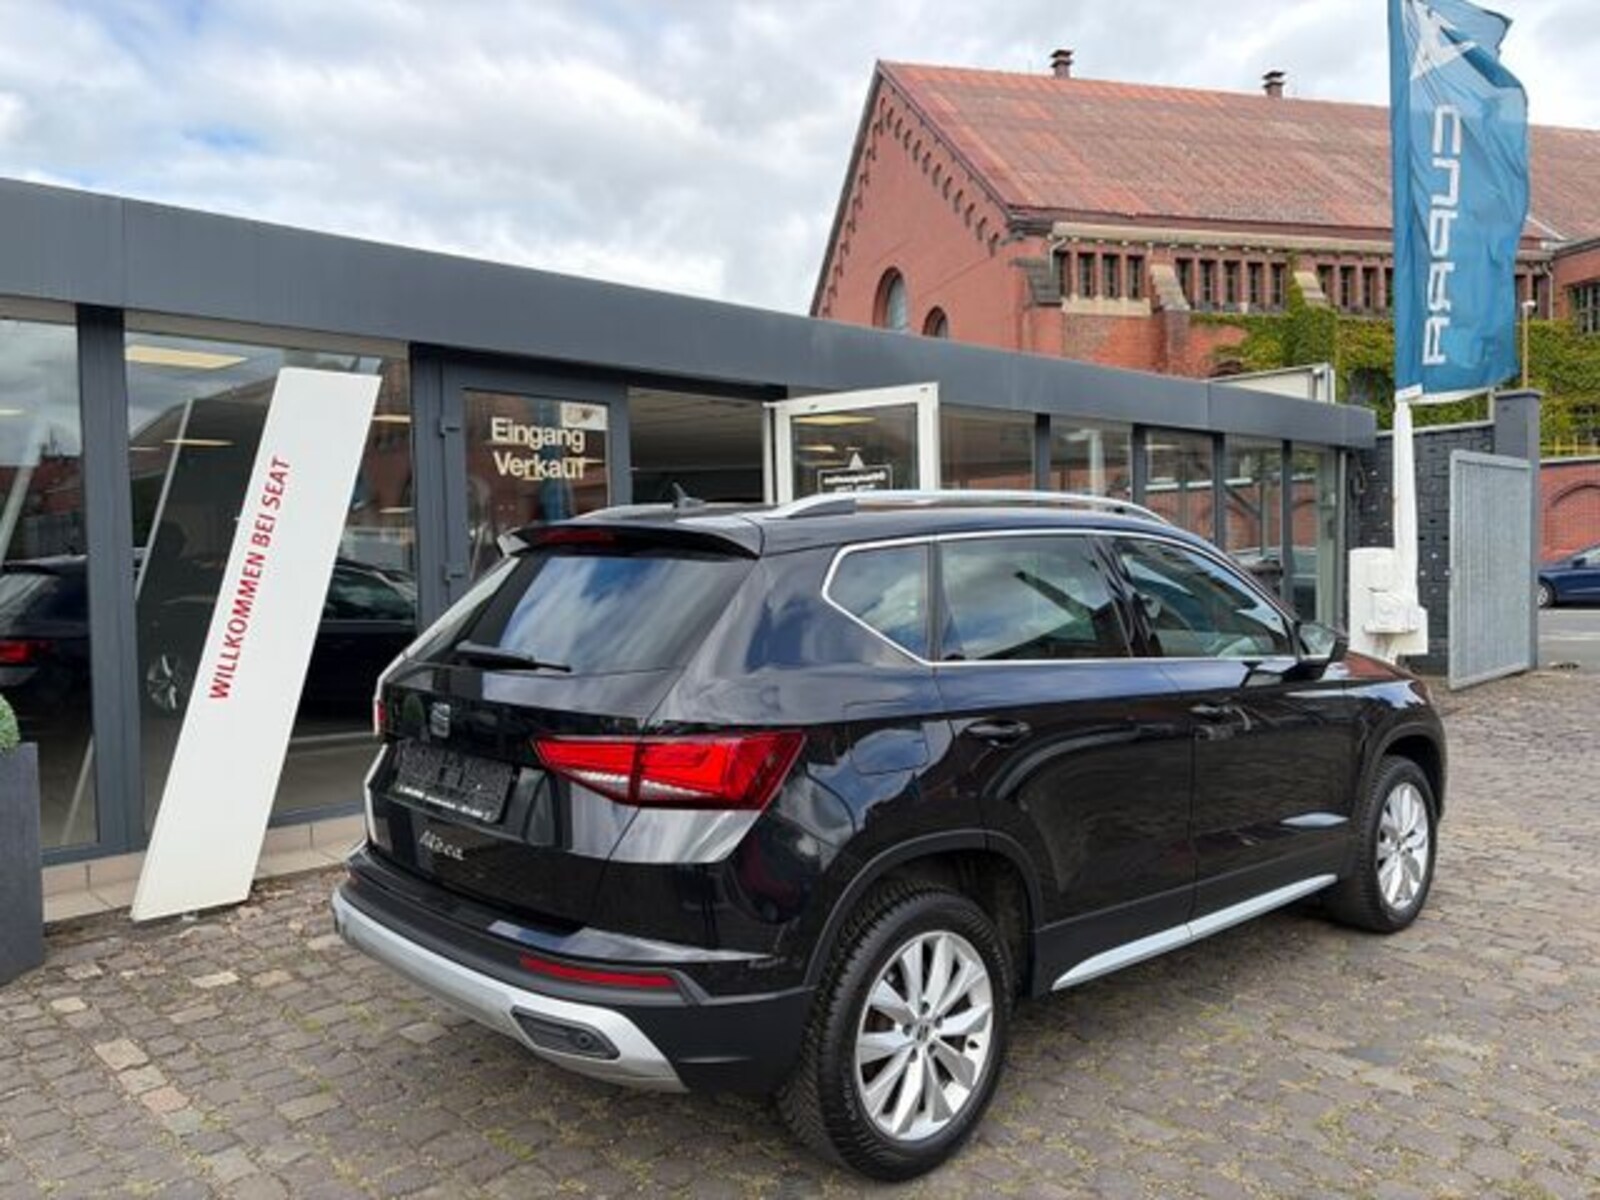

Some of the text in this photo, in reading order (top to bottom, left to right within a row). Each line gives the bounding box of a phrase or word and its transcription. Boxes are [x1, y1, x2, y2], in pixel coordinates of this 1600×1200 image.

[491, 416, 586, 454] Eingang
[492, 450, 586, 480] Verkauf
[208, 455, 291, 700] WILLKOMMEN BEI SEAT
